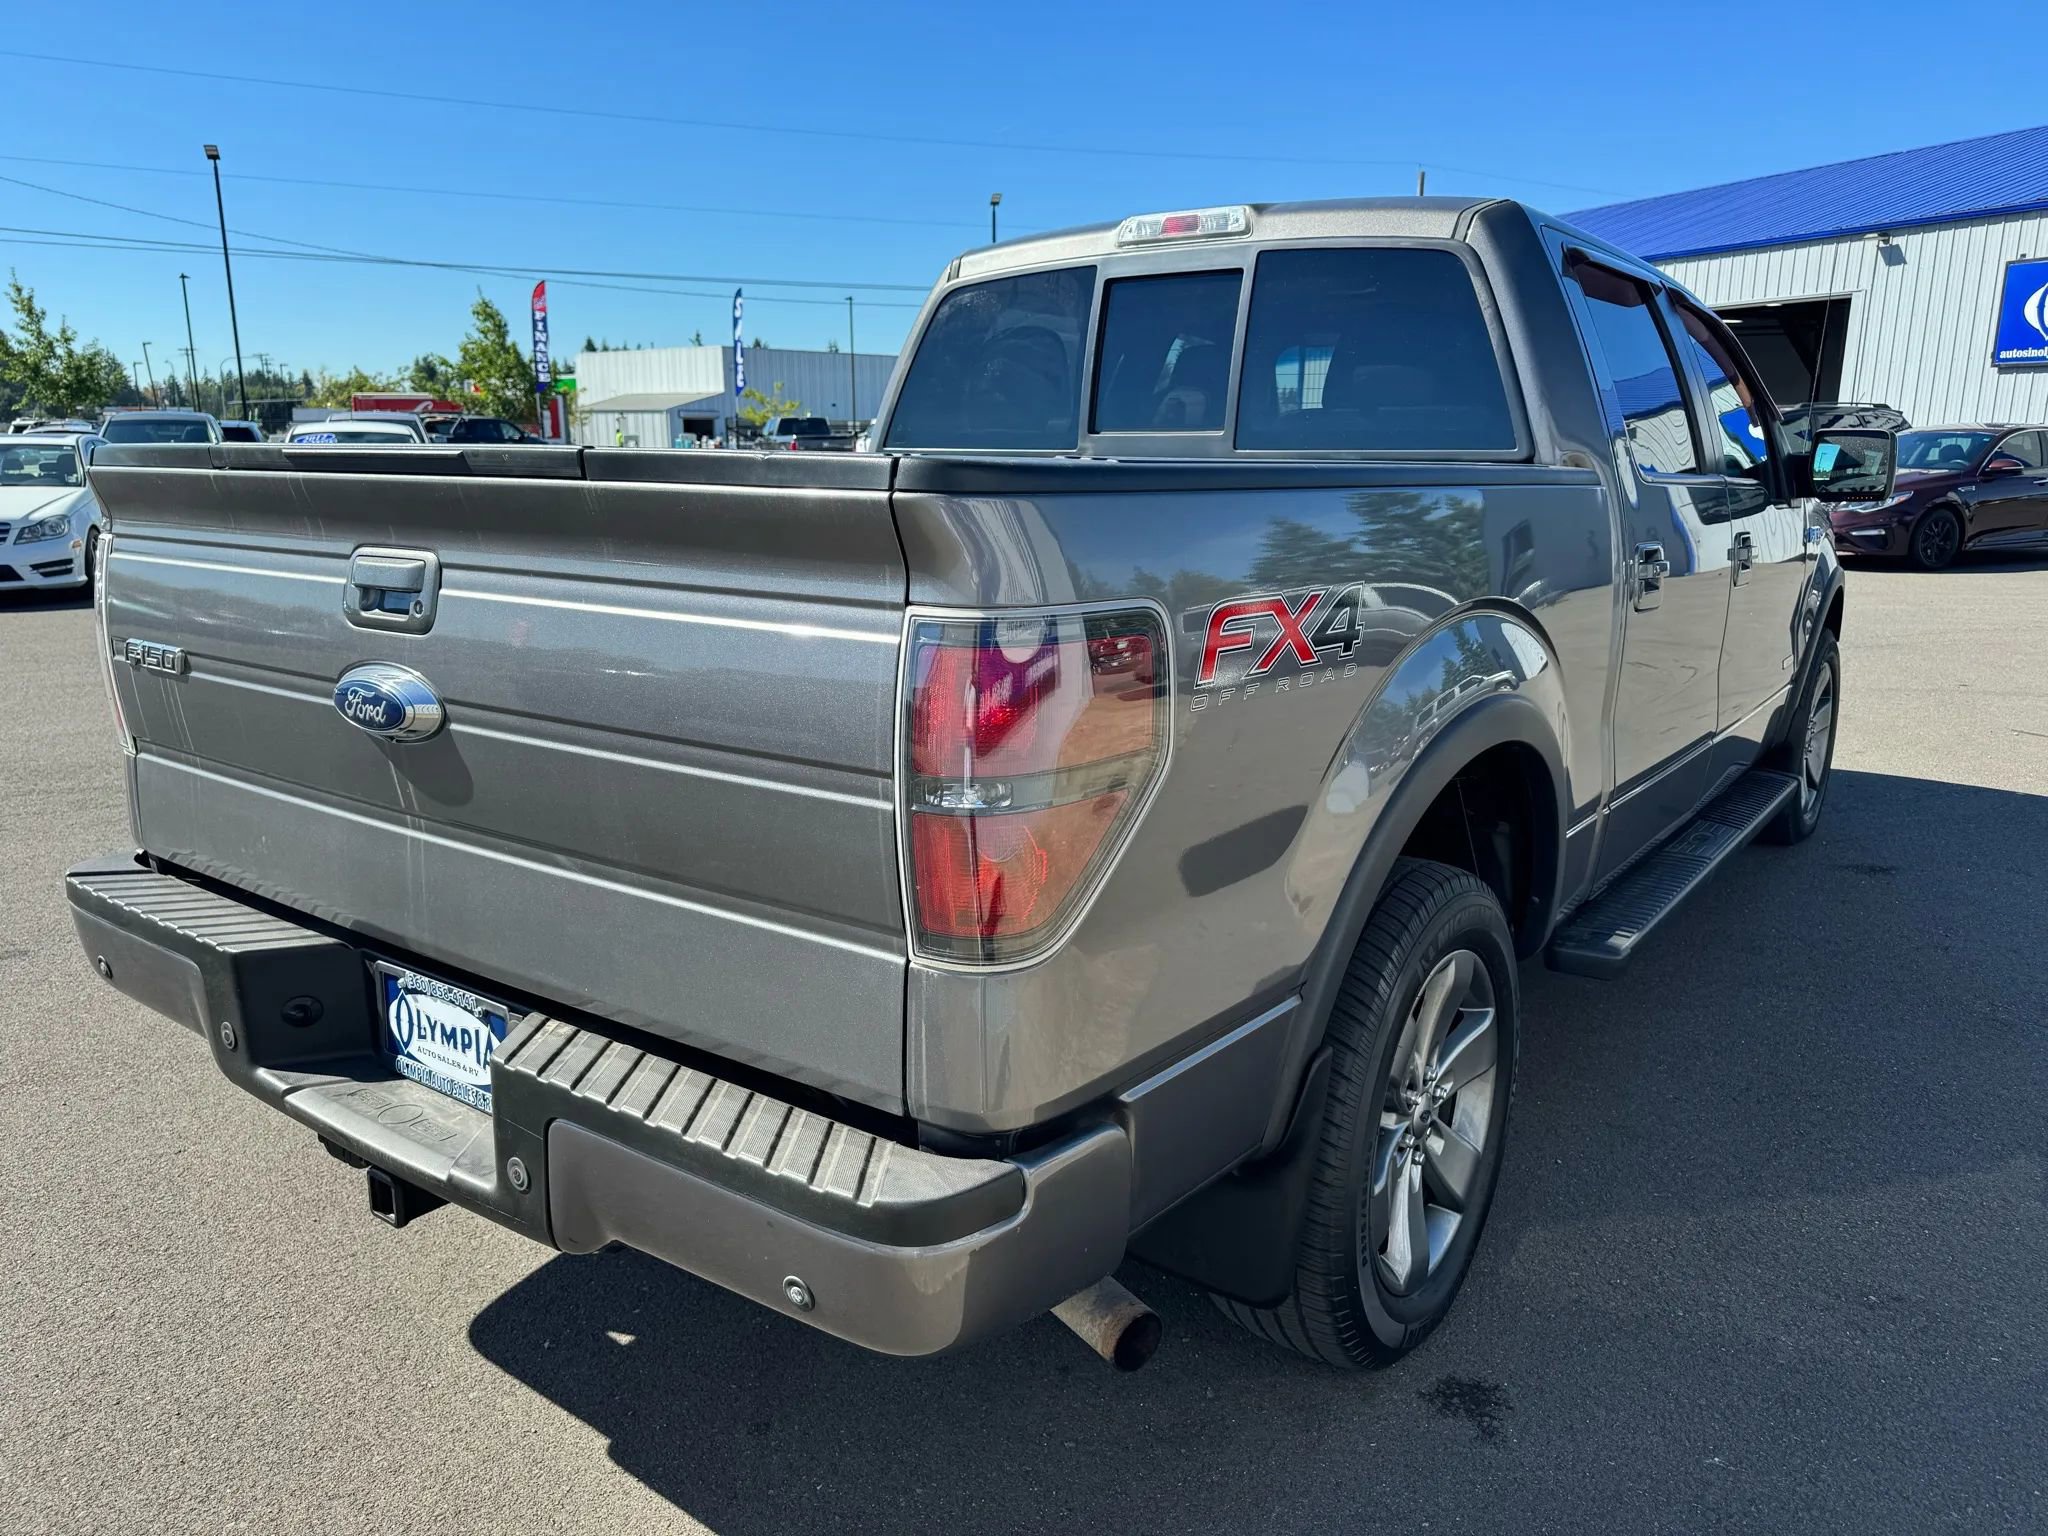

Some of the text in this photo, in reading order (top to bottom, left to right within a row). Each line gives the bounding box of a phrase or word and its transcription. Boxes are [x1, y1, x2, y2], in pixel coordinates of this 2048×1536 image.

[534, 311, 551, 382] FINANCE
[735, 297, 744, 387] SALE
[1999, 346, 2048, 359] autosinol
[1194, 581, 1365, 689] FX4
[344, 687, 387, 723] Ford
[1190, 662, 1359, 713] OFF ROAD
[405, 972, 476, 1013] (360) 858-4141
[396, 1056, 431, 1086] OLYMPIA
[430, 1071, 453, 1094] AUTO
[453, 1081, 476, 1105] SALES
